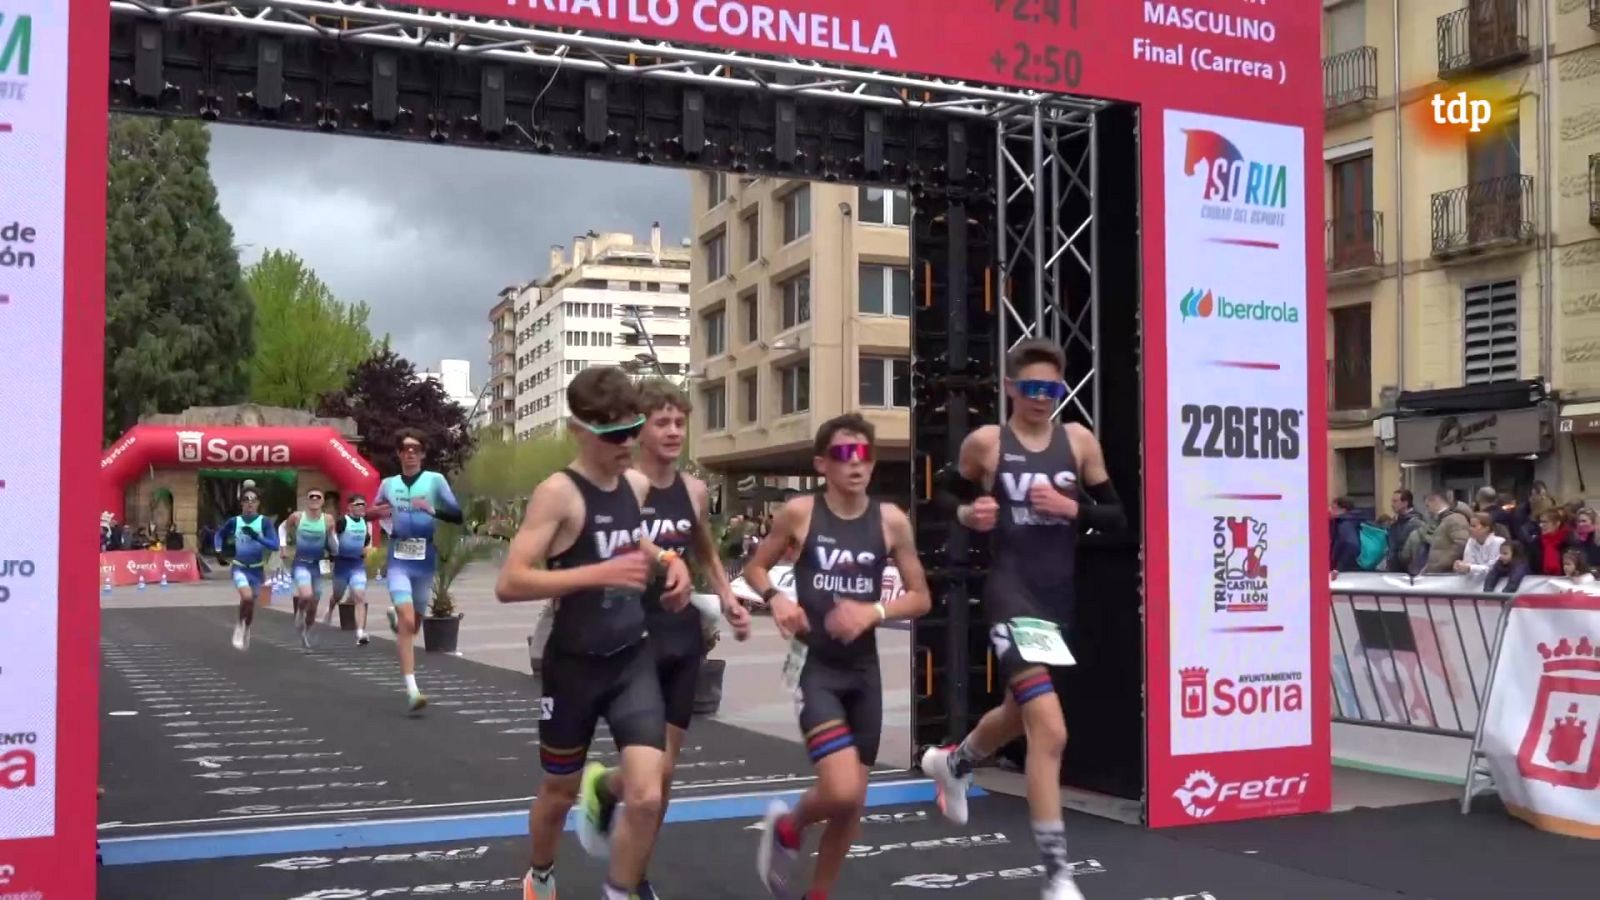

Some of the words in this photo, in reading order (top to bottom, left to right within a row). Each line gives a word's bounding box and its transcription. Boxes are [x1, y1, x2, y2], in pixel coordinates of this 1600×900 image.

[692, 0, 898, 58] CORNELLA
[1143, 1, 1276, 43] MASCULINO
[990, 42, 1081, 88] +2:50
[1132, 38, 1183, 66] Final
[1210, 157, 1287, 208] SORIA
[0, 221, 36, 243] de
[1217, 297, 1298, 323] Iberdrola
[1181, 404, 1300, 460] 226ERS
[207, 437, 290, 464] Soria
[815, 546, 875, 571] VAS
[1213, 516, 1226, 612] TRIATLON
[813, 573, 874, 593] GUILLÉN
[1227, 580, 1268, 591] CASTILLA
[1227, 594, 1233, 603] Y
[1239, 672, 1302, 683] AYUNTAMIENTO
[1212, 678, 1303, 716] Soria
